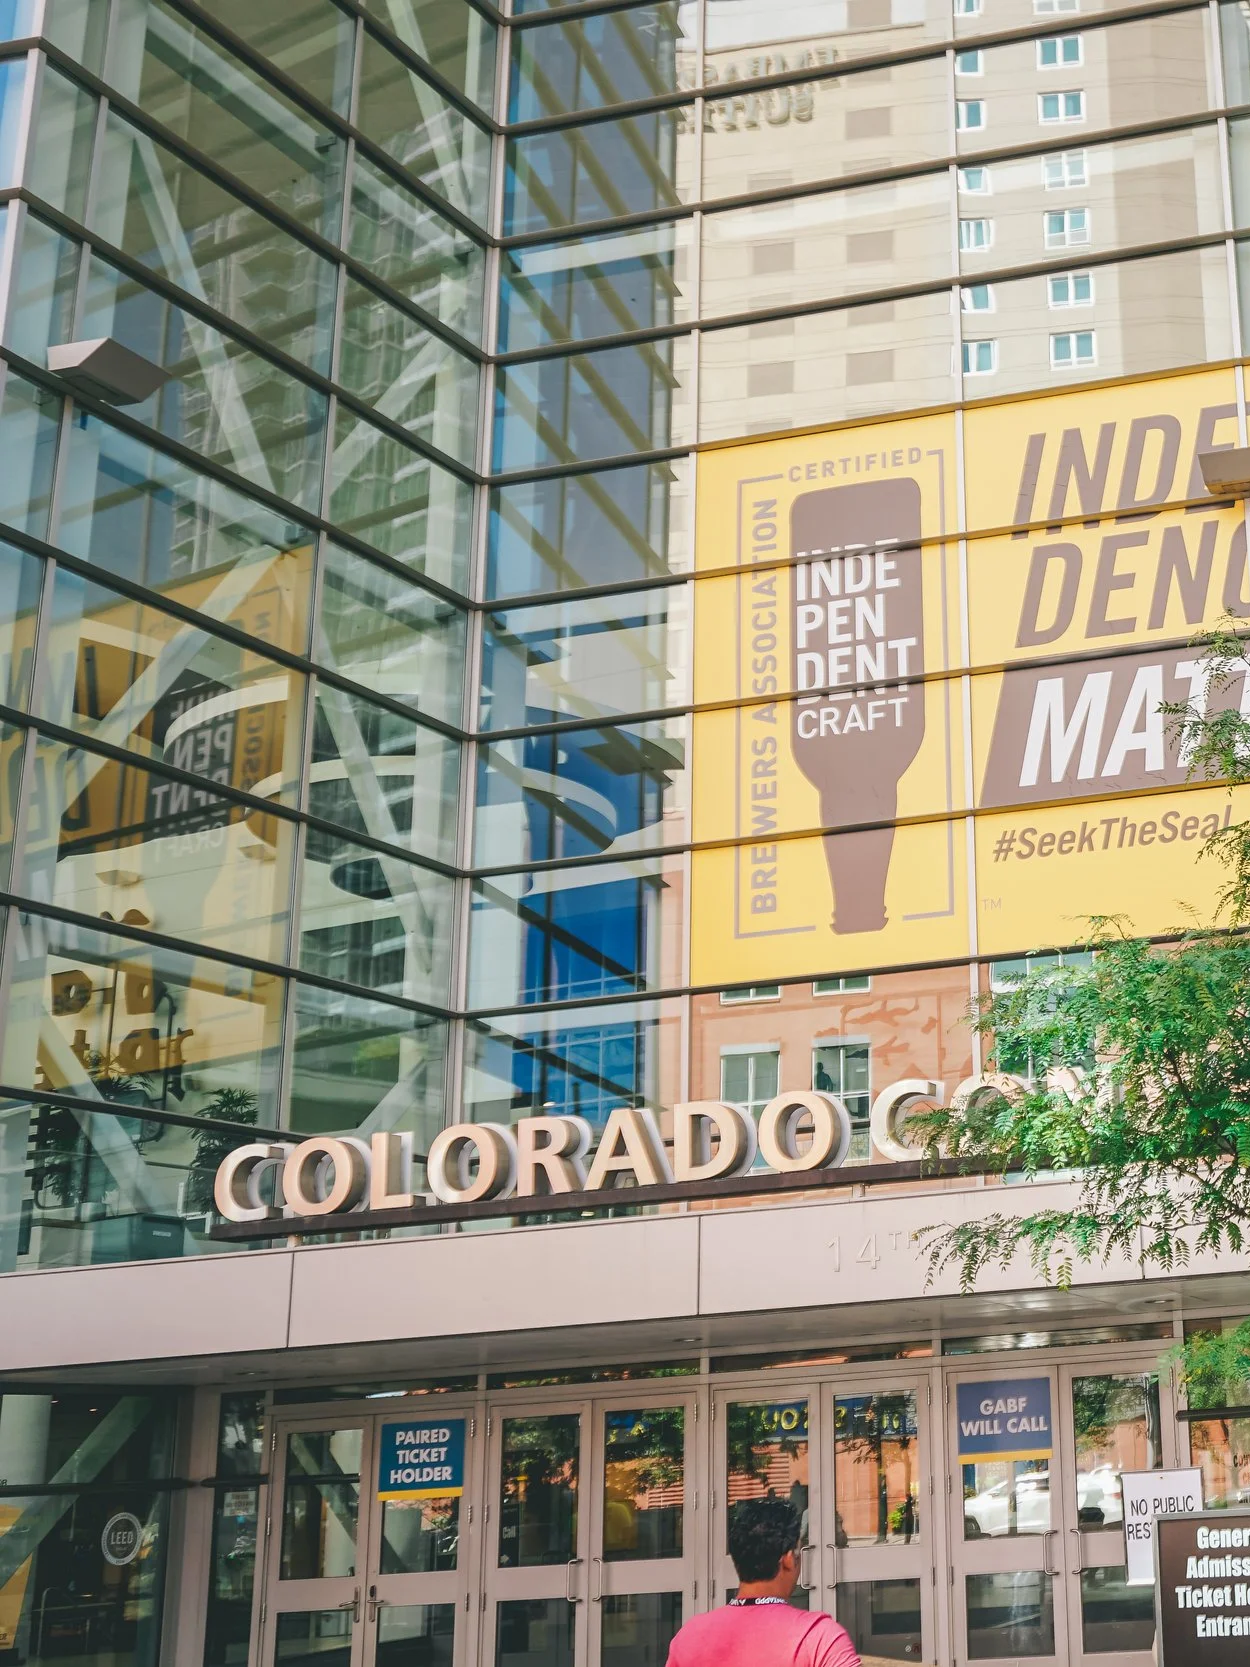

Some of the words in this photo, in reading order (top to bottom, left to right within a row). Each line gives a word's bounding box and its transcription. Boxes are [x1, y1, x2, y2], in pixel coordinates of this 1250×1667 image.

[788, 447, 922, 483] CERTIFIED
[796, 537, 900, 601] INDE
[751, 499, 777, 724] ASSOCIATION
[796, 593, 885, 648] PEN
[796, 636, 917, 706] DENT
[796, 697, 909, 739] CRAFT
[751, 735, 777, 914] BREWERS
[992, 804, 1232, 863] #SeekTheSeal
[213, 1090, 851, 1223] COLORADO
[979, 1397, 1028, 1416] GABF
[395, 1428, 451, 1446] PAIRED
[960, 1420, 1001, 1438] WILL
[1006, 1416, 1048, 1433] CALL
[396, 1448, 447, 1465] TICKET
[389, 1466, 453, 1484] HOLDER
[1130, 1498, 1149, 1515] NO
[1152, 1495, 1195, 1513] PUBLIC
[110, 1531, 134, 1545] LEED
[1174, 1585, 1233, 1609] Ticket
